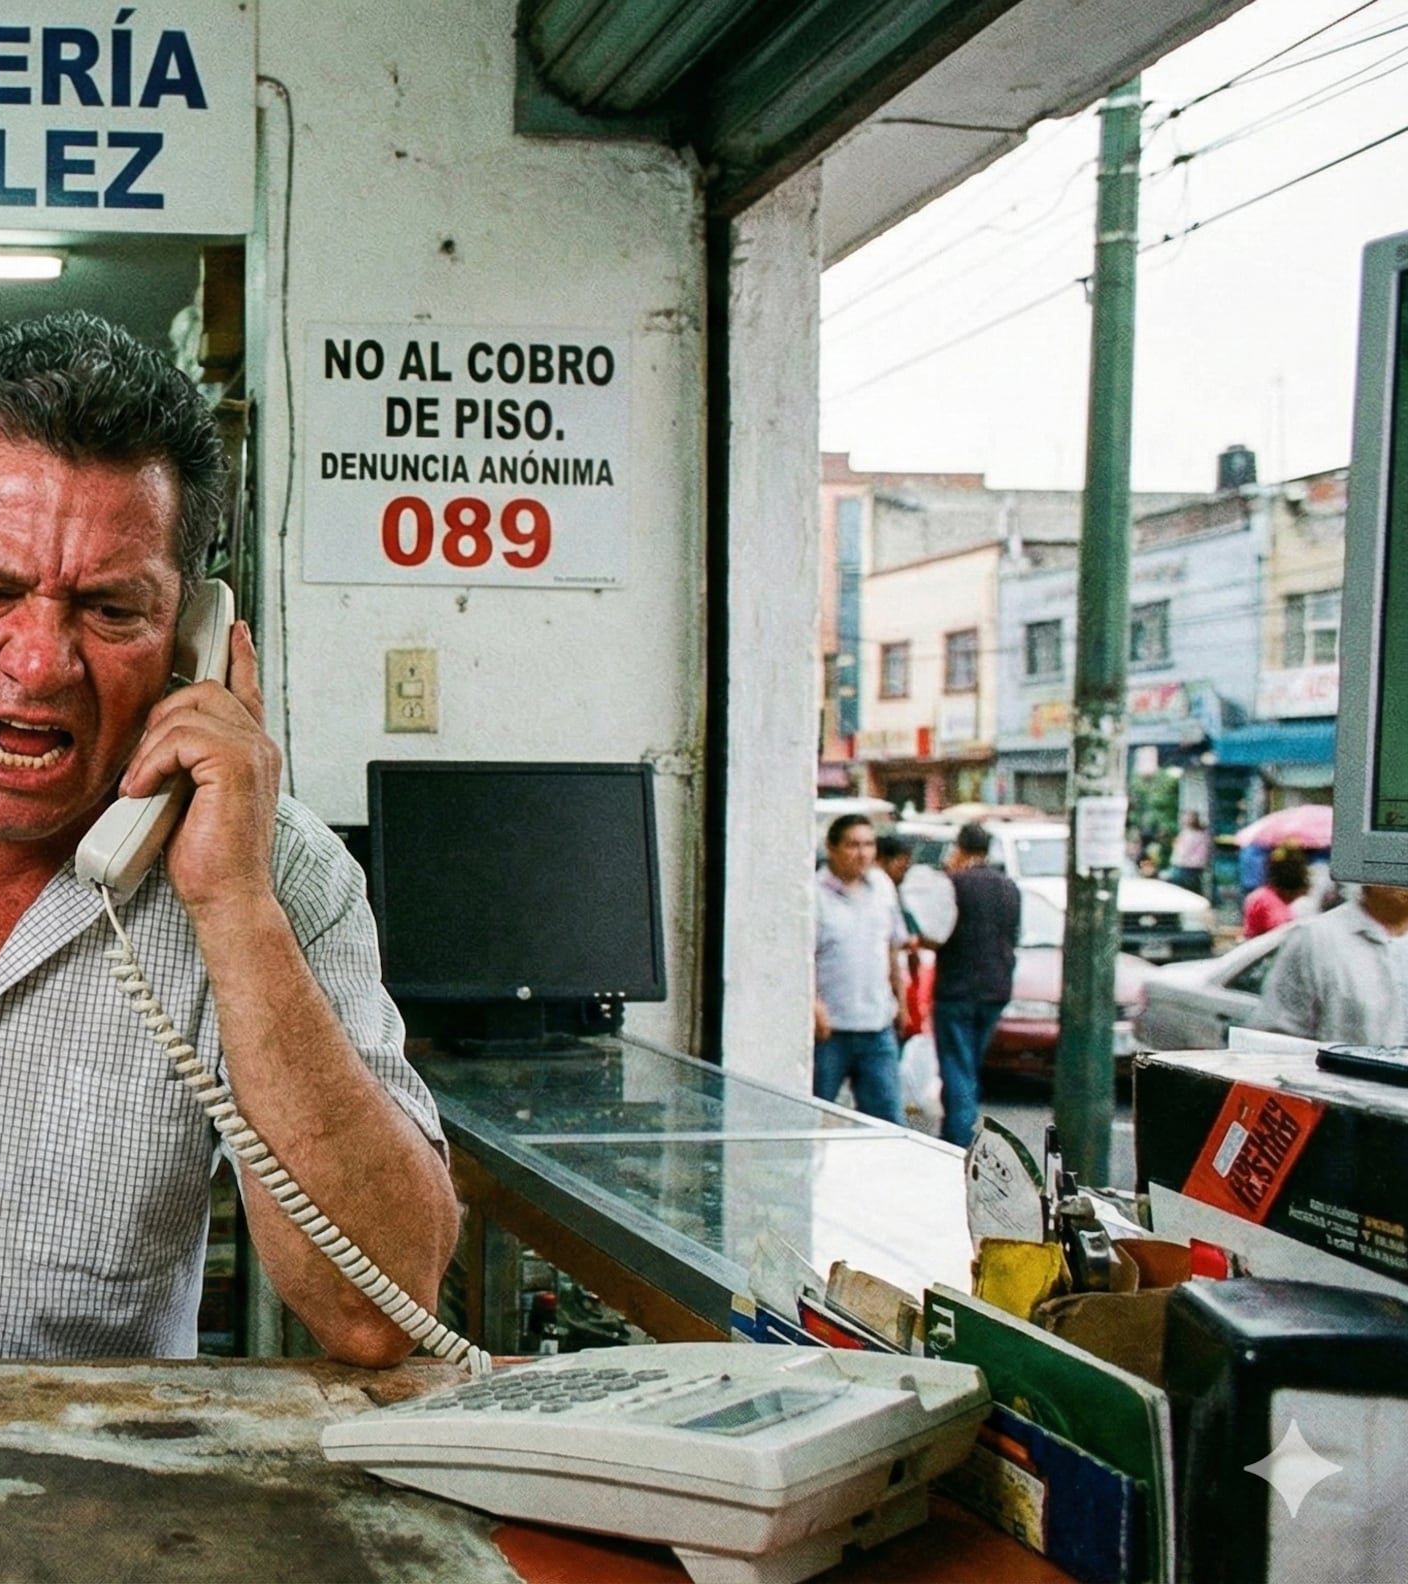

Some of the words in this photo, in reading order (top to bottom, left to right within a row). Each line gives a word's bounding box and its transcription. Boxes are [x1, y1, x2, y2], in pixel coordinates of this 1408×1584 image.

[324, 339, 384, 380] NO
[399, 341, 452, 382] AL
[468, 342, 614, 386] COBRO
[387, 397, 439, 438] DE
[455, 398, 564, 440] PISO.
[321, 453, 470, 483] DENUNCIA
[479, 450, 614, 486] ANÓNIMA
[382, 496, 552, 569] 089
